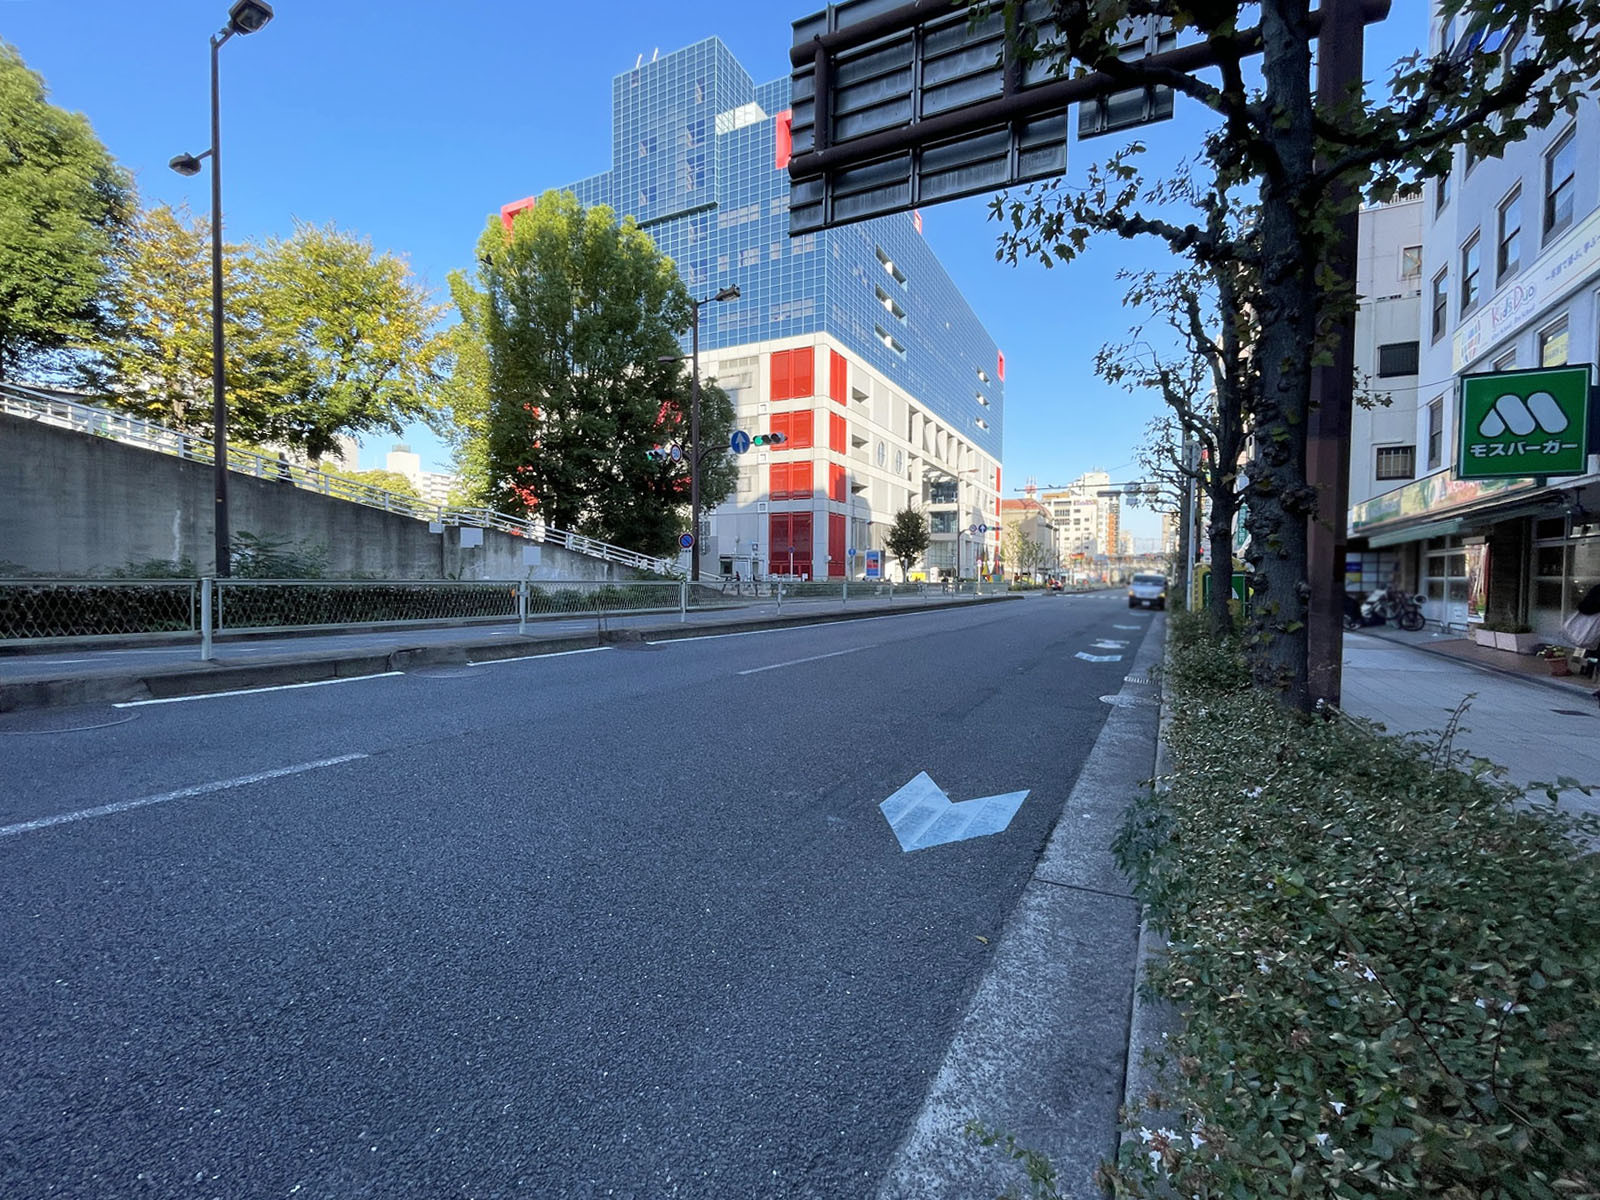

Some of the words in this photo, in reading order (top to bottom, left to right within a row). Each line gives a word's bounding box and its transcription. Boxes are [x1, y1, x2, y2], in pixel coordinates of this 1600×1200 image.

[1470, 440, 1578, 457] モスバーガー
